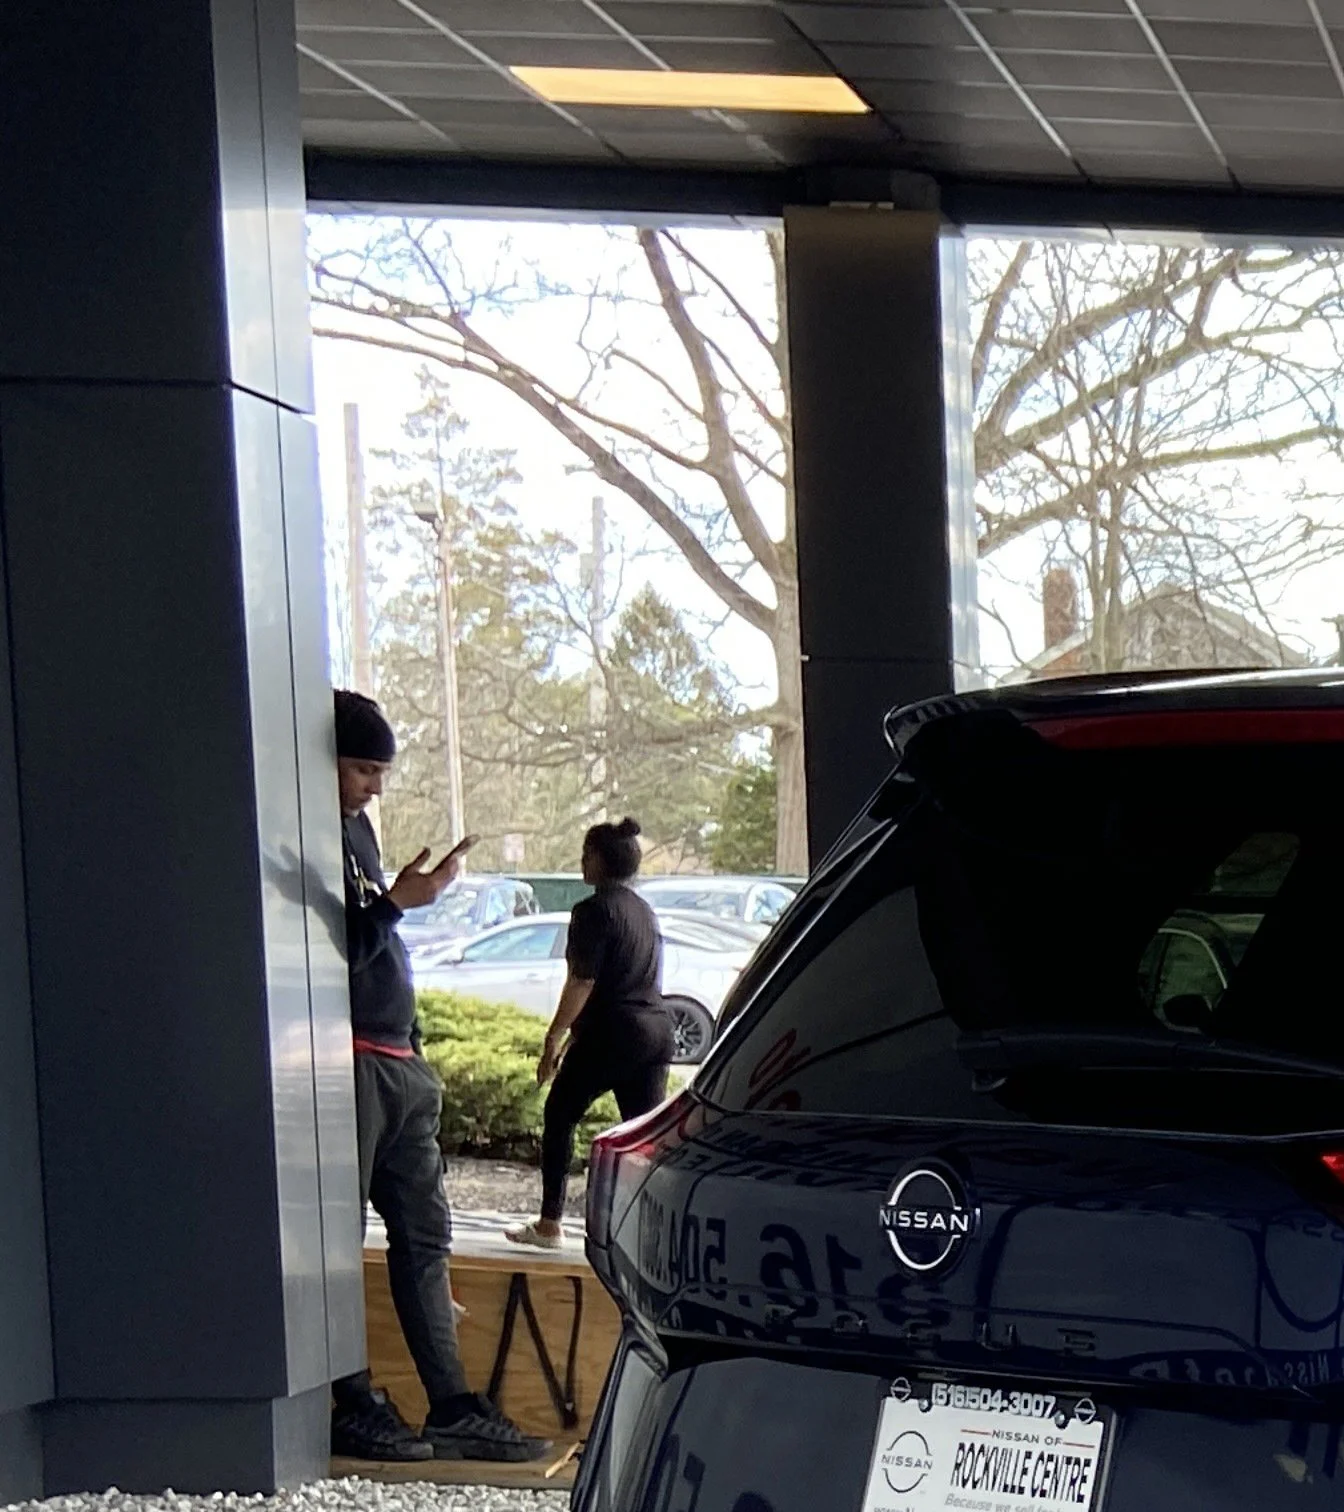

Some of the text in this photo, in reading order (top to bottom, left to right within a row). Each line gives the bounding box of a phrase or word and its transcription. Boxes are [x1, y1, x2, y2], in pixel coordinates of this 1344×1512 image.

[879, 1208, 969, 1232] NISSAN
[991, 1429, 1064, 1446] NISSAN OF
[881, 1454, 933, 1470] NISSAN
[951, 1442, 1093, 1503] ROCKVILLE CENTRE
[944, 1493, 992, 1512] Because
